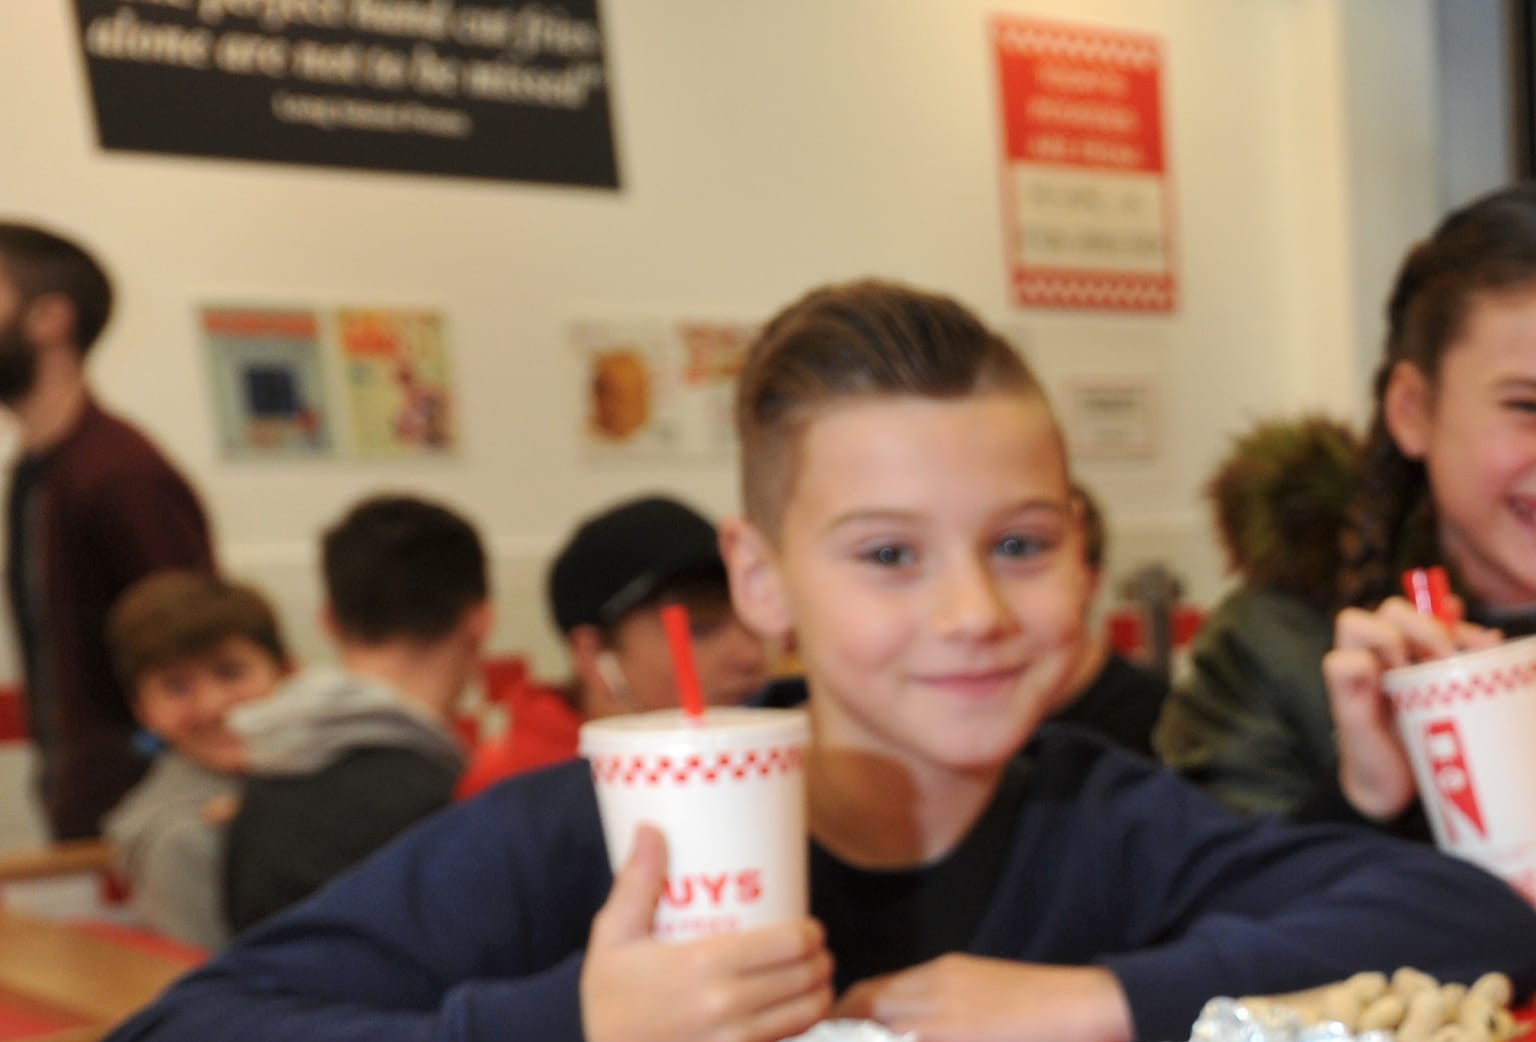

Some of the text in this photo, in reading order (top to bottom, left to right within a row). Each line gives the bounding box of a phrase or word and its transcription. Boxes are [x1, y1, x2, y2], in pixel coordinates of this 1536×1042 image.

[88, 9, 214, 69] alone
[216, 32, 290, 77] are
[292, 38, 360, 84] not
[364, 44, 407, 89] to
[409, 42, 459, 96] be
[662, 870, 763, 908] UYS
